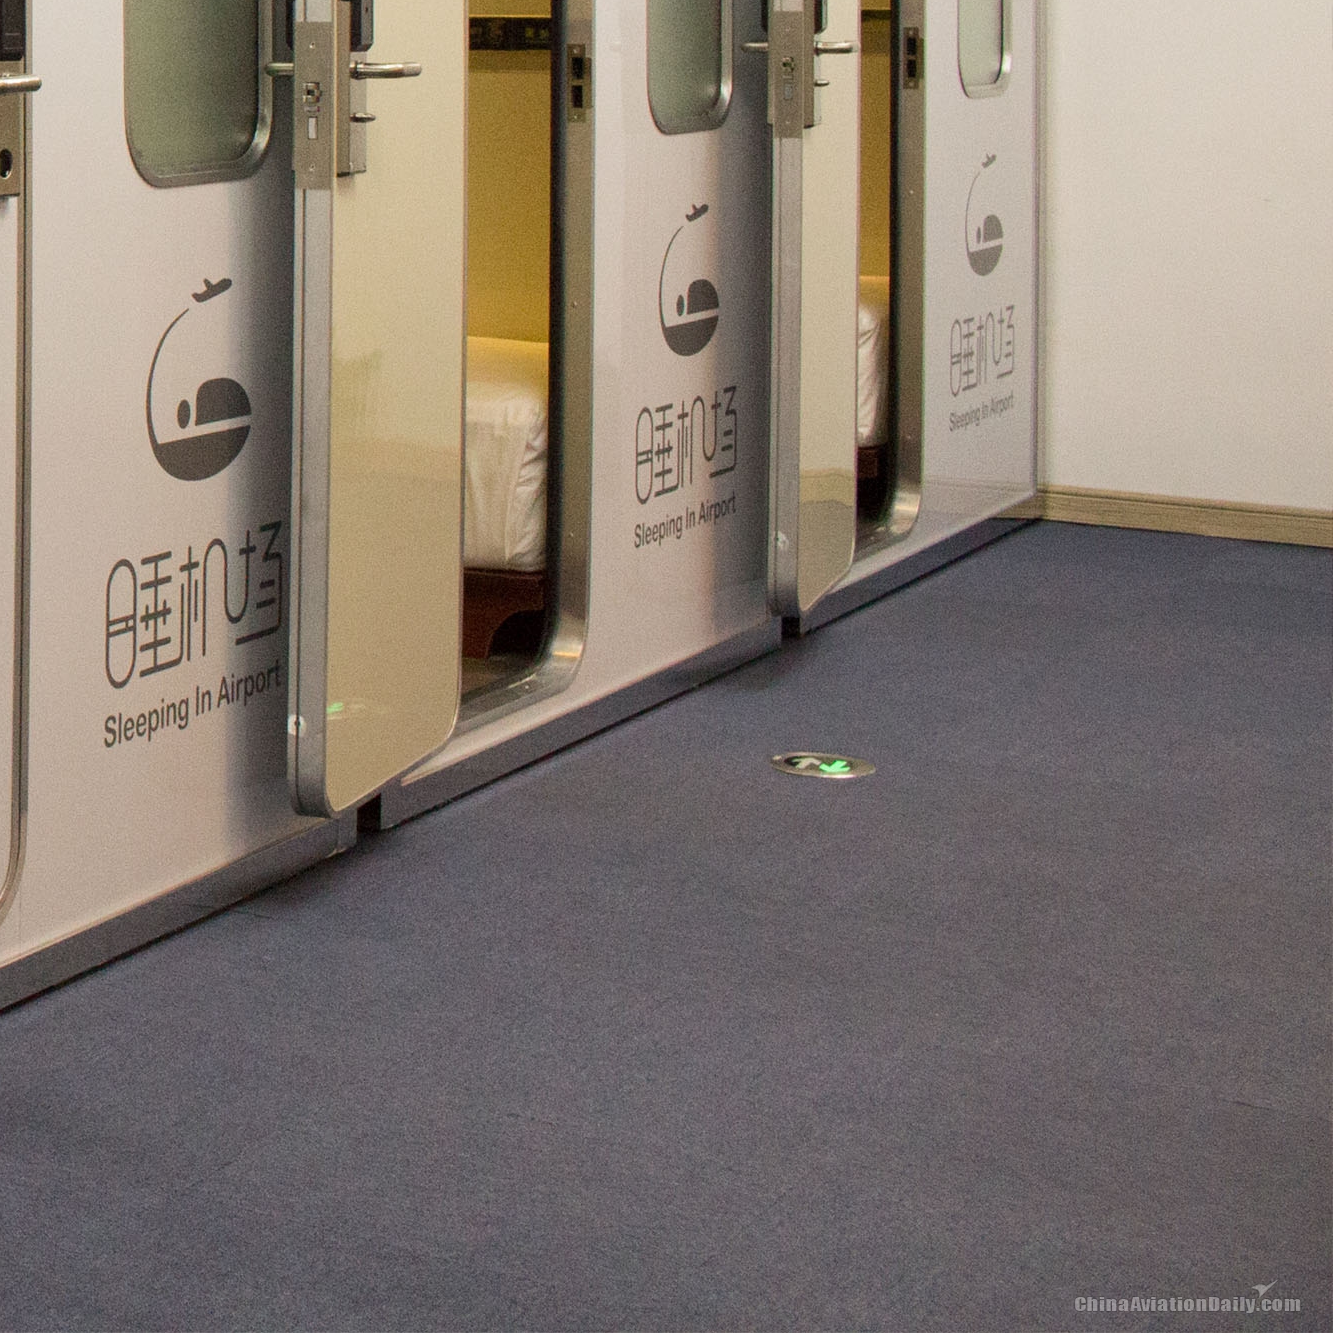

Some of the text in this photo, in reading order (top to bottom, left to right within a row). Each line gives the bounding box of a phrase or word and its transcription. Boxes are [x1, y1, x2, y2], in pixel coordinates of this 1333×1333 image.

[634, 490, 736, 548] Sleeping In Airport
[104, 659, 282, 748] Sleeping In Airport
